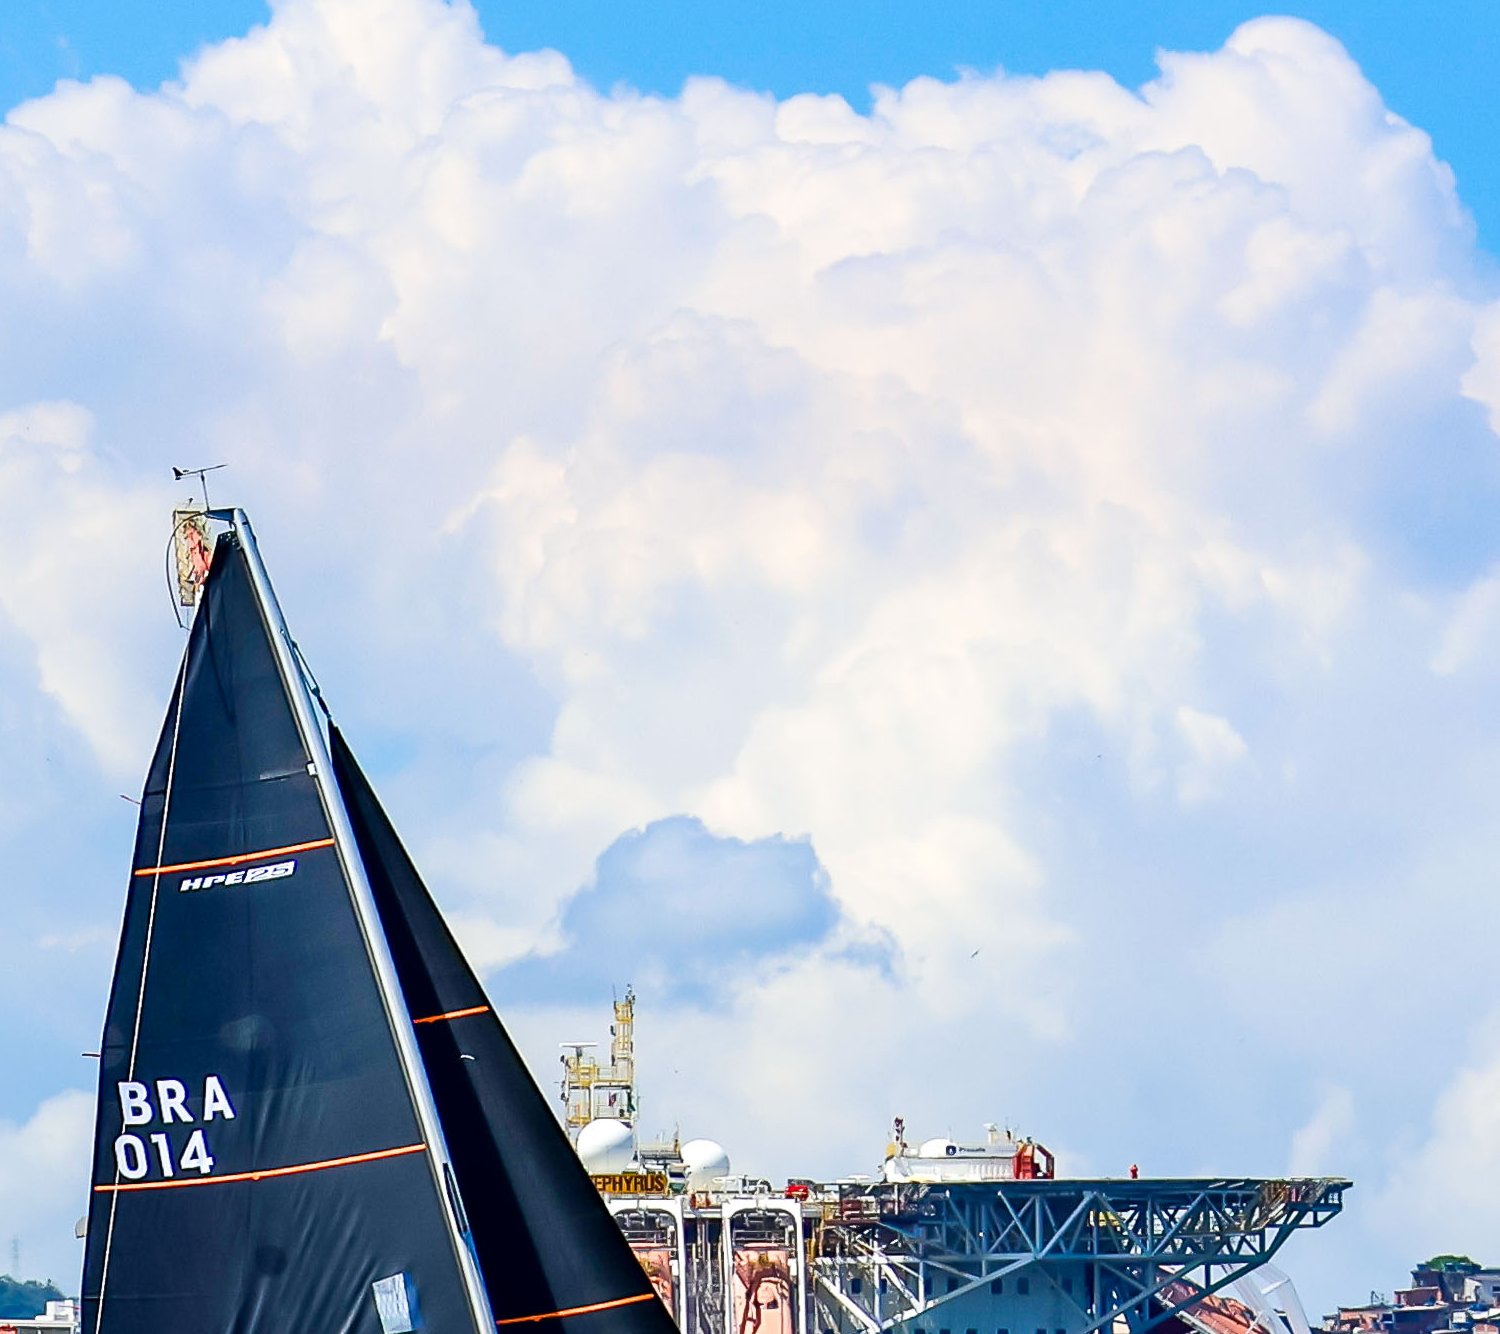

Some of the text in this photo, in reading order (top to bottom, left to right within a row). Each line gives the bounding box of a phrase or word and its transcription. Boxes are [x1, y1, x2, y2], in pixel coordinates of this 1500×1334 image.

[118, 1076, 235, 1125] BRA
[115, 1129, 214, 1179] 014
[591, 1174, 666, 1192] EPHYRUS
